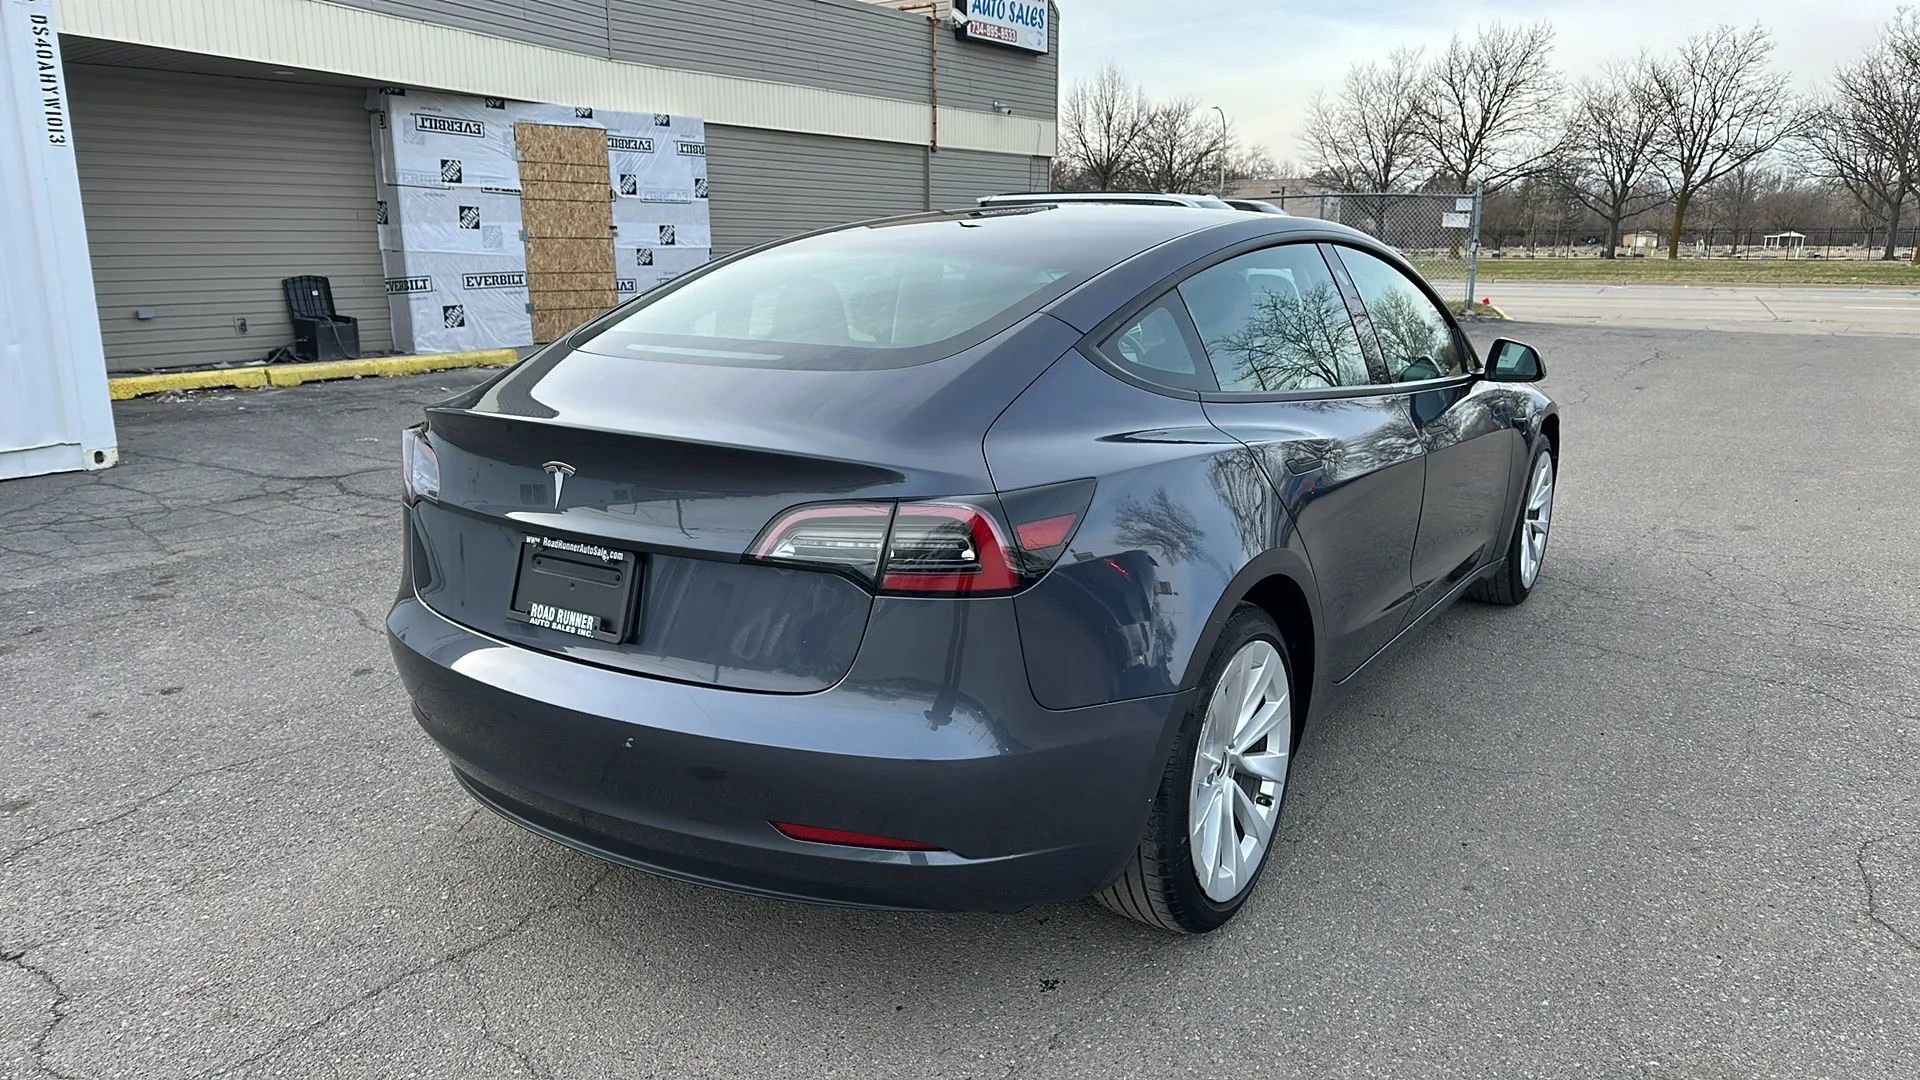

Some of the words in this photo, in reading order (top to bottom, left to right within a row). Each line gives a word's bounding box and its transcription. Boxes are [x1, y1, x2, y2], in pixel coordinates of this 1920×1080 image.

[972, 0, 1005, 19] AUTO
[1009, 1, 1045, 29] SALES
[971, 21, 1017, 41] 734-895-8533
[419, 117, 482, 134] EVERBILT
[608, 137, 652, 150] EVERBIL
[465, 274, 524, 287] EVERBILT
[530, 603, 555, 621] ROAD
[557, 609, 594, 631] RUNNER
[529, 617, 550, 628] AUTO
[552, 622, 576, 634] SALES
[577, 628, 594, 638] INC.
